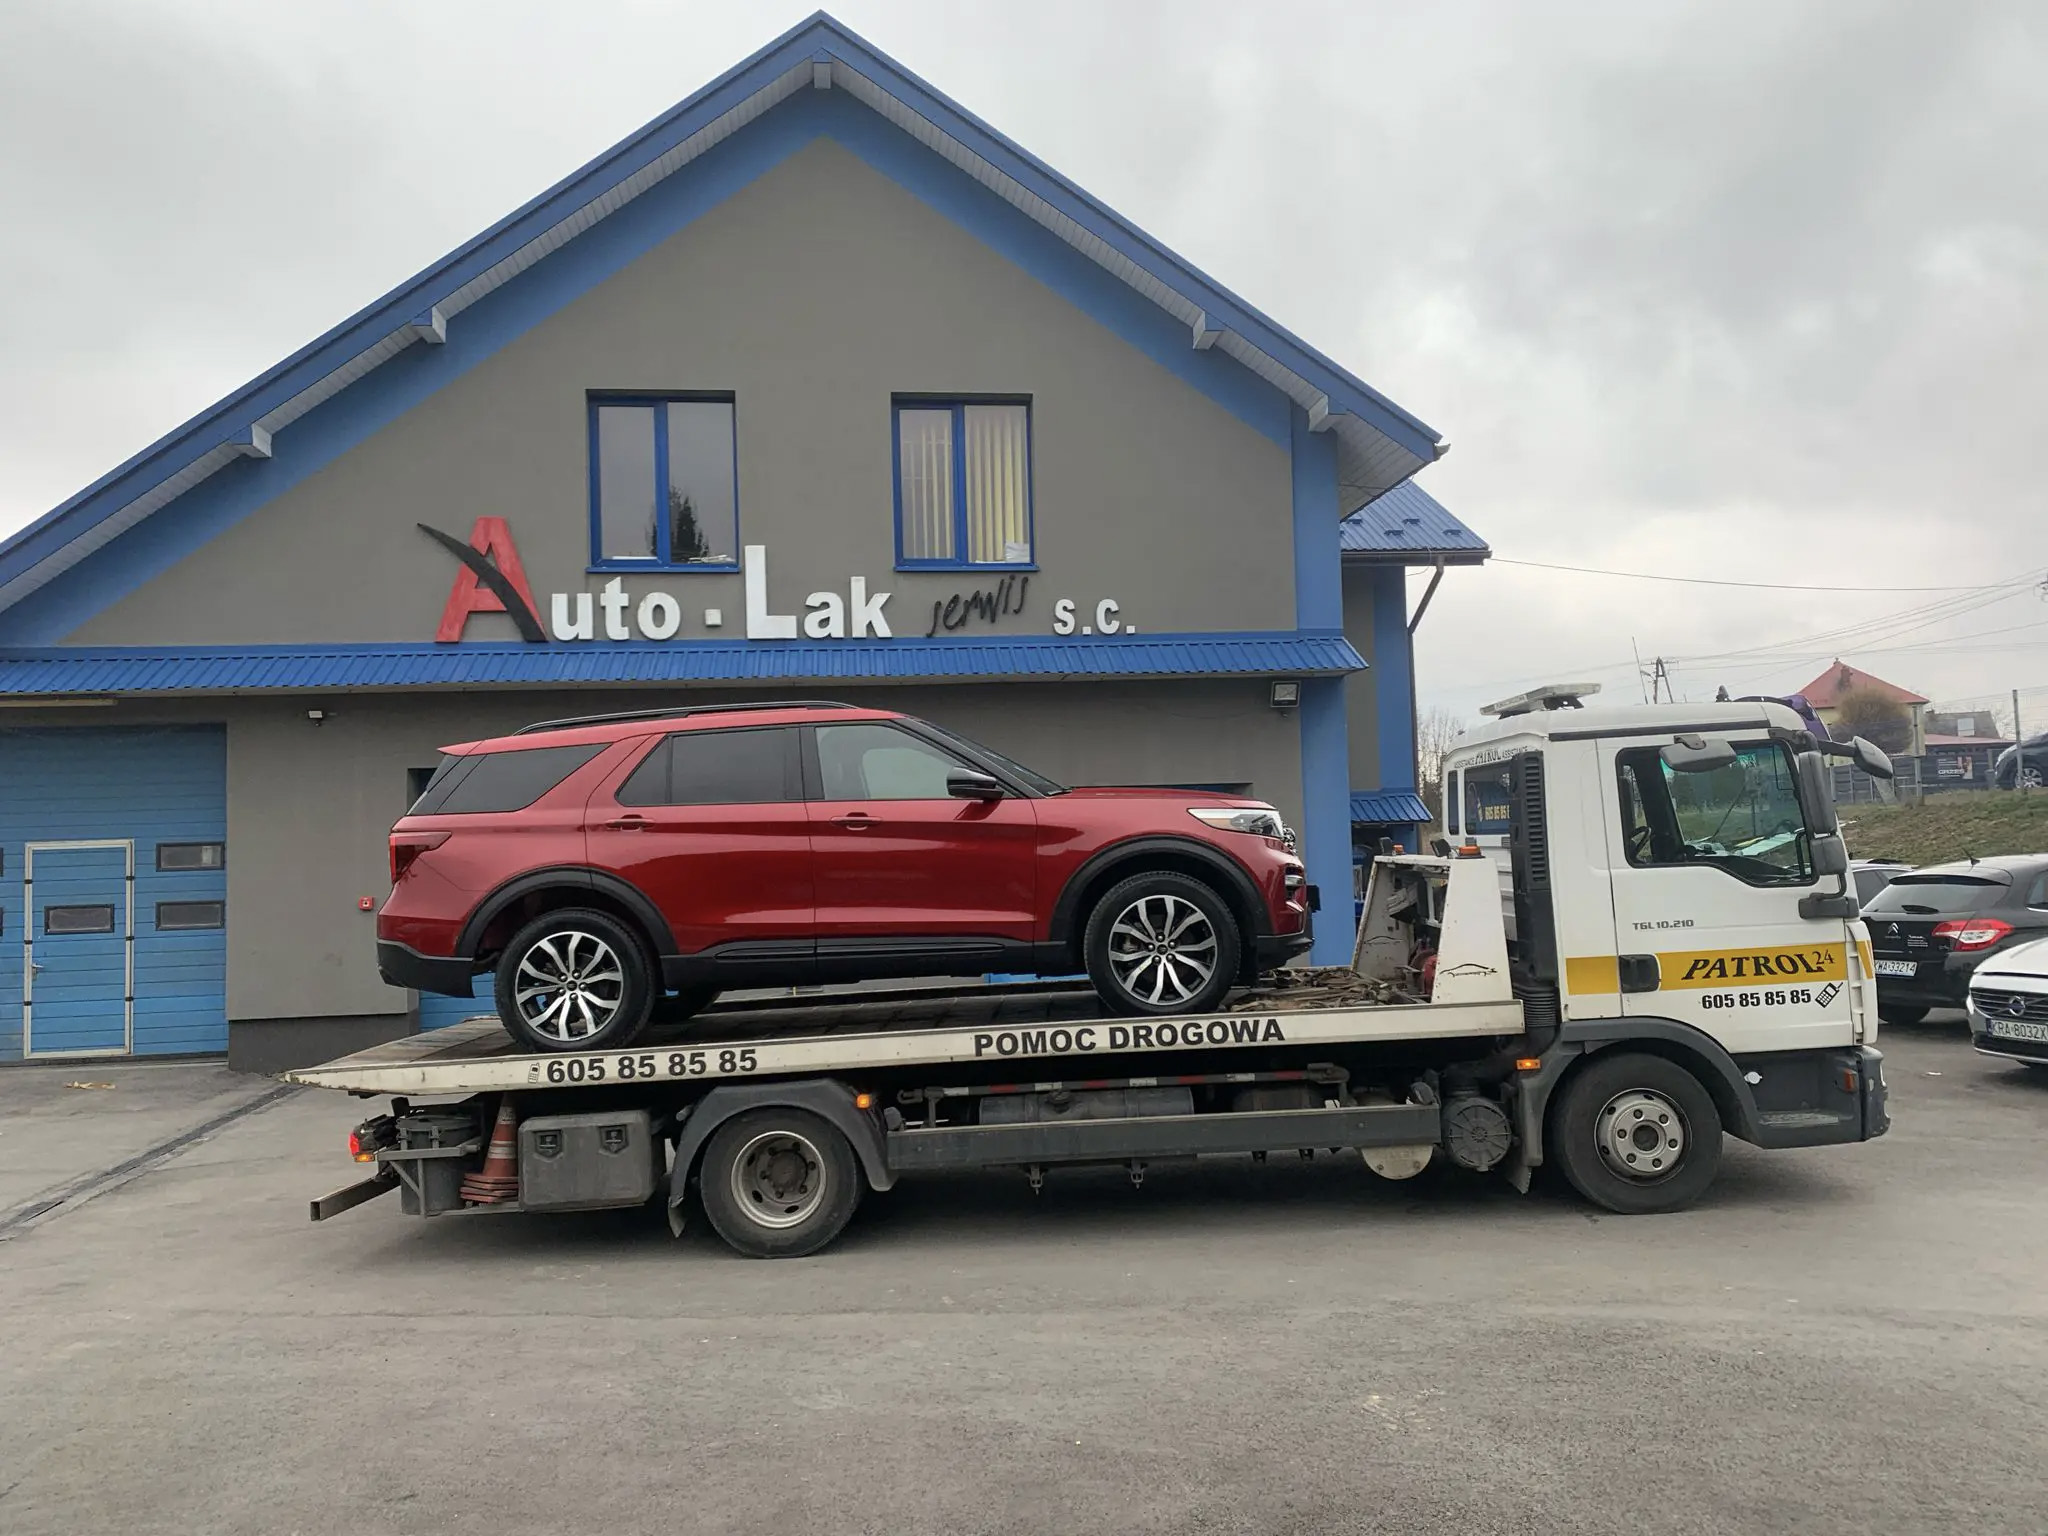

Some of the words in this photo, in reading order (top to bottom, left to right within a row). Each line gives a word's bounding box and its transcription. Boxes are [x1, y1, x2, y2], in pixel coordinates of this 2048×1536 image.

[433, 516, 681, 642] Auto
[744, 545, 893, 639] Lak
[1053, 598, 1136, 635] s.c.
[1681, 953, 1825, 980] PATROL
[1701, 994, 1735, 1009] 605
[1739, 992, 1761, 1007] 85
[1765, 990, 1786, 1006] 85
[1790, 989, 1811, 1004] 85
[974, 1028, 1097, 1057] POMOC
[1108, 1018, 1286, 1050] DROGOWA
[547, 1058, 605, 1083] 605
[617, 1055, 656, 1079] 85
[668, 1052, 706, 1076] 85
[718, 1049, 757, 1073] 85
